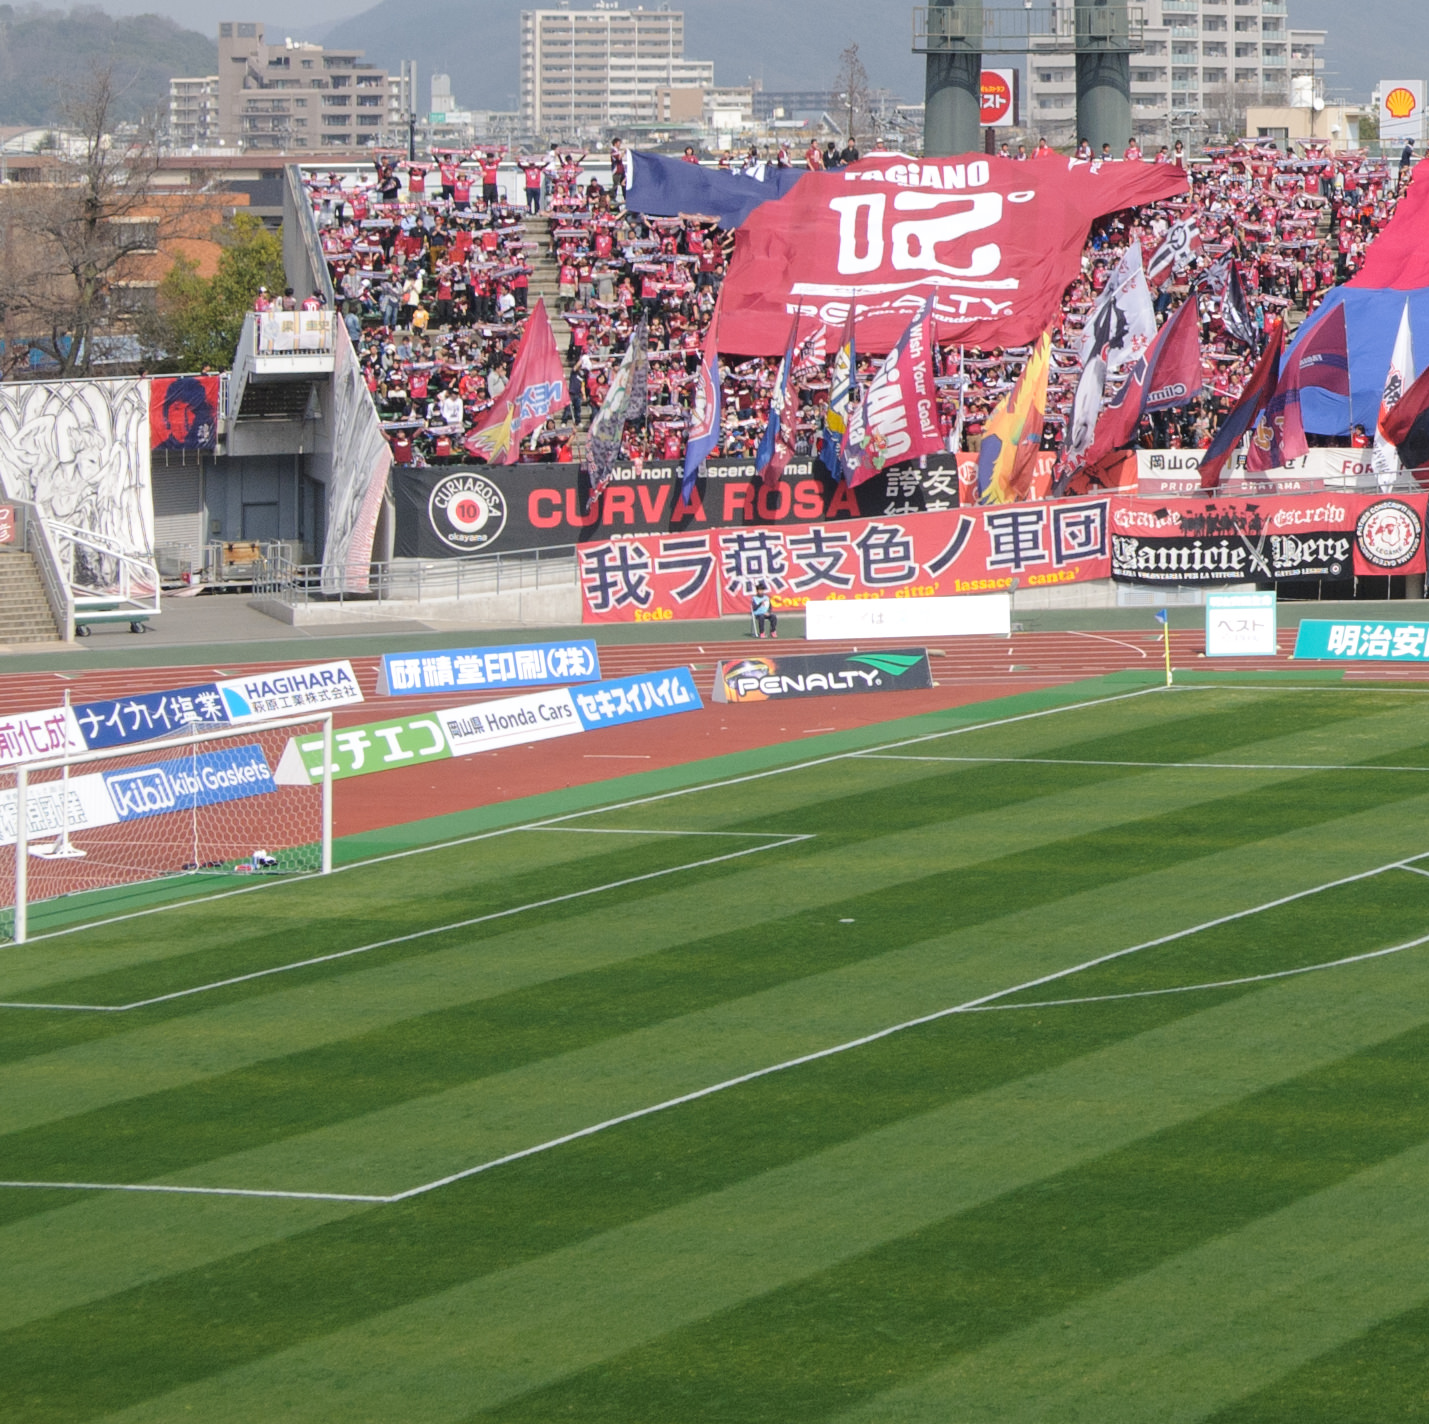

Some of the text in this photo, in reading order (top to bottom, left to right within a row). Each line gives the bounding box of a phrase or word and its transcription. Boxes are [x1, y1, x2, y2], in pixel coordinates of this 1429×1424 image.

[912, 361, 927, 396] Your
[641, 466, 672, 480] non
[784, 461, 813, 475] mai
[435, 478, 502, 517] CURVAROSA
[457, 504, 477, 518] 10
[528, 479, 862, 529] CURVA ROSA
[244, 667, 352, 699] HAGIHARA
[576, 676, 692, 723] セキスイハイム
[738, 669, 878, 697] PENALTY
[78, 691, 225, 739] ナイカイ塩業
[446, 701, 573, 739] 岡山県 Honda Cars
[302, 719, 446, 777] ニチエコ
[204, 760, 272, 789] Gaskets
[112, 773, 172, 816] kibi
